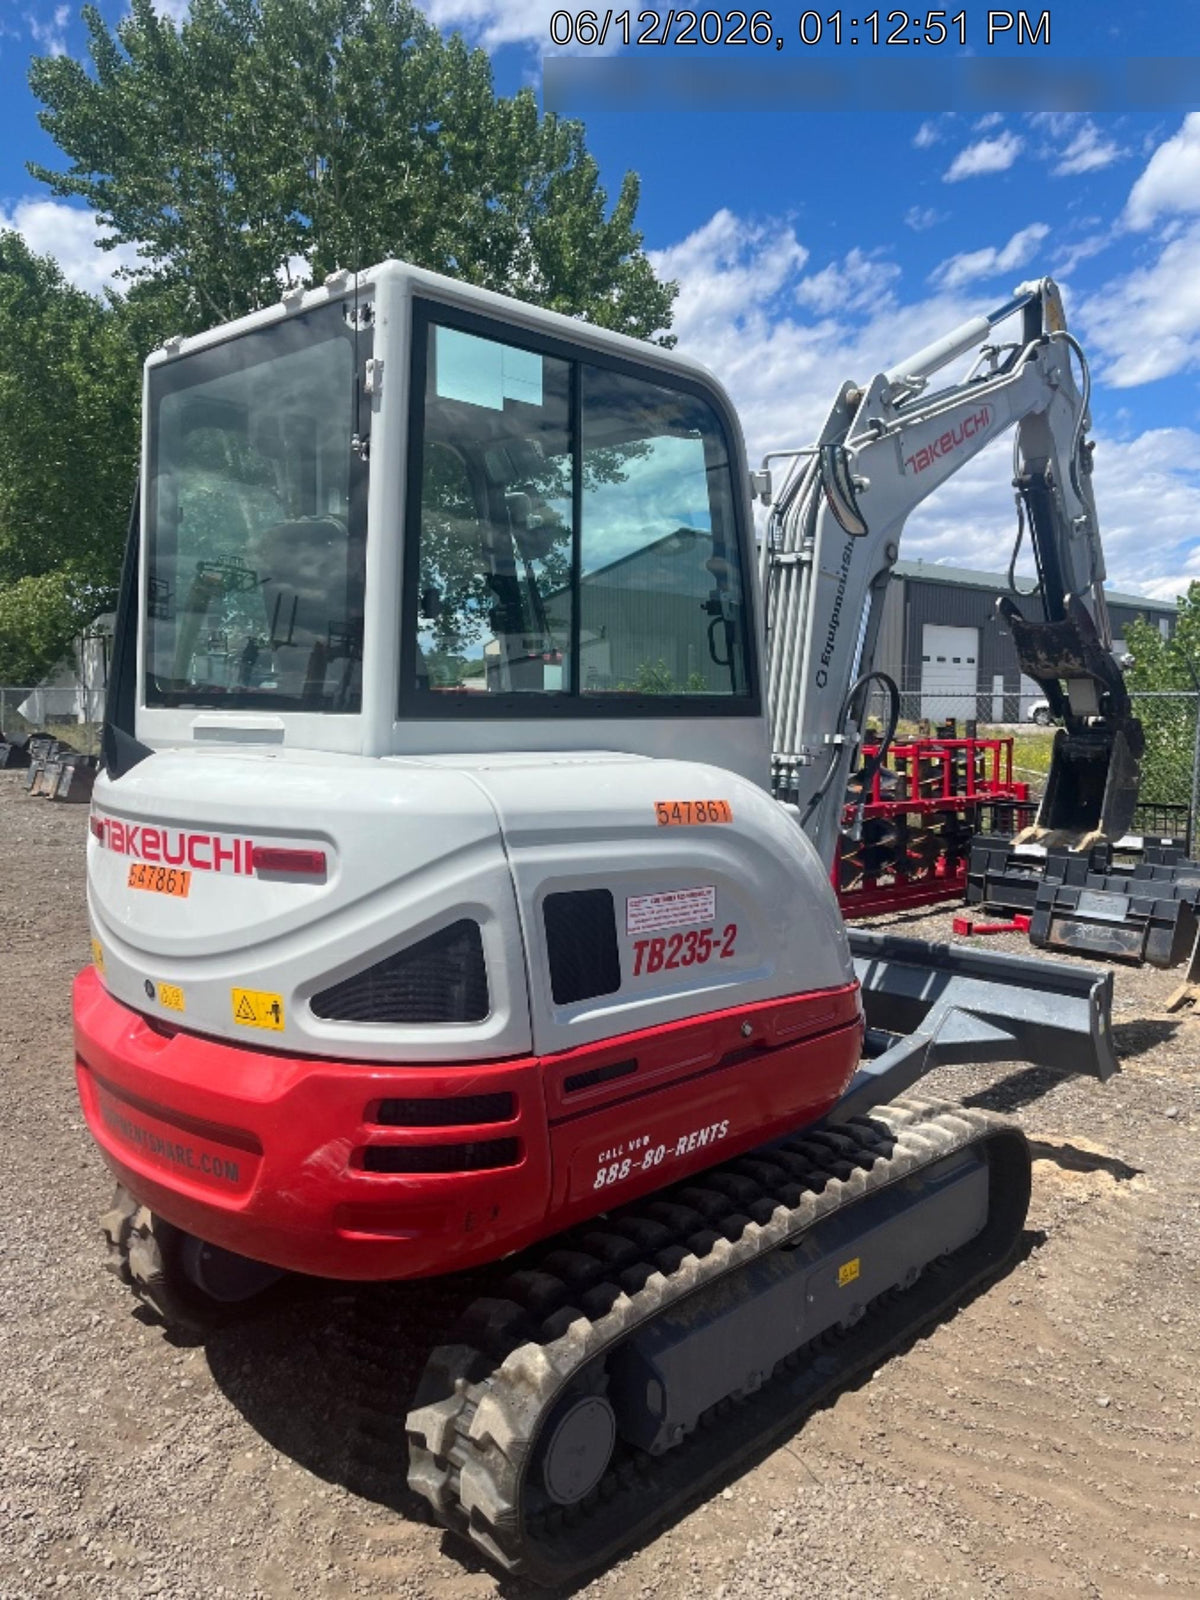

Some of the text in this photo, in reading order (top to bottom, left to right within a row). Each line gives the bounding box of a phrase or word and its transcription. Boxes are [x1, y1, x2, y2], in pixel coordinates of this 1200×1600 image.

[657, 800, 730, 826] 547861
[129, 864, 187, 894] 547861
[632, 923, 738, 977] TB235-2
[593, 1120, 729, 1189] 888-80-RENTS
[598, 1145, 624, 1163] CALL
